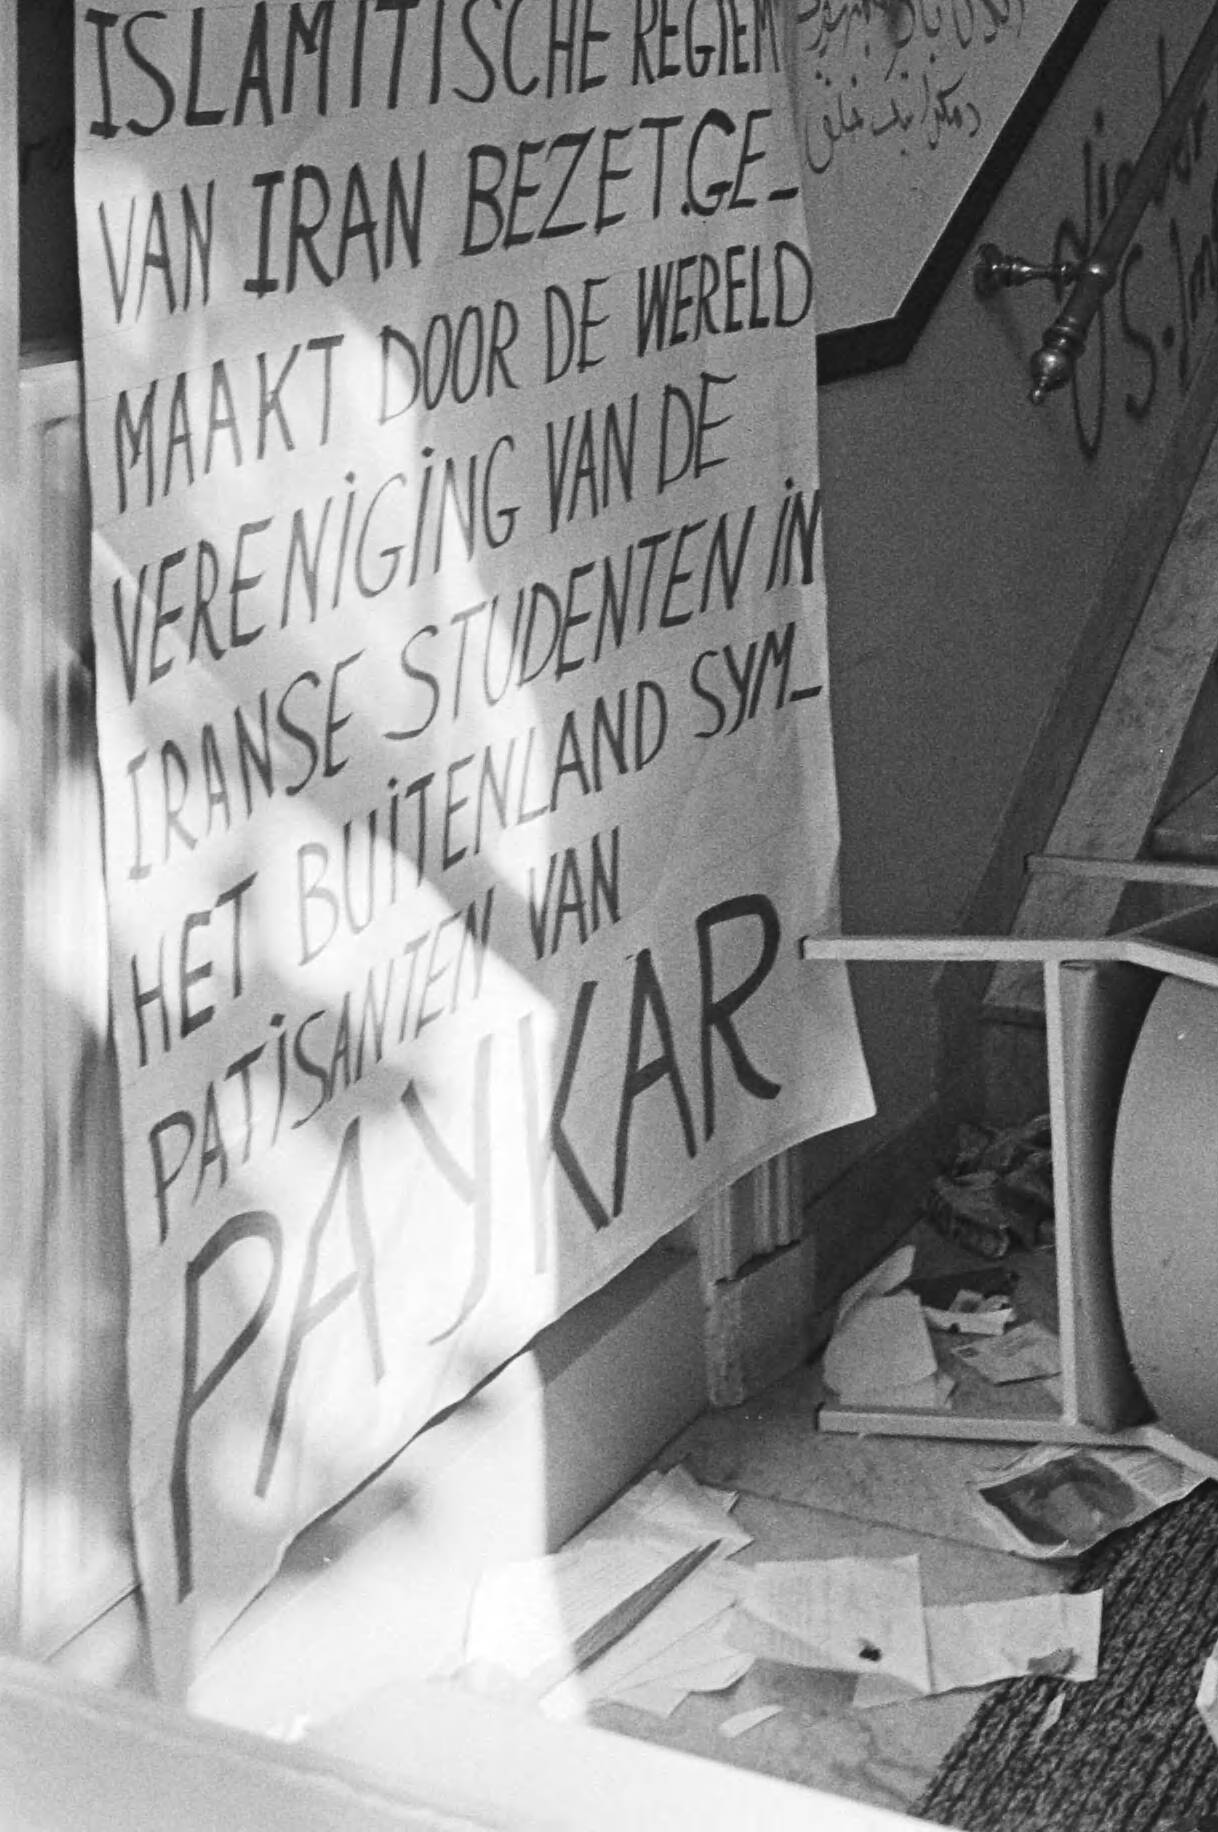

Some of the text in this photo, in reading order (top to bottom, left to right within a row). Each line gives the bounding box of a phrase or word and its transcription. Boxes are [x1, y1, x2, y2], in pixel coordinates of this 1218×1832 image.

[97, 178, 215, 326] VAN
[242, 148, 426, 298] IRAN
[112, 240, 815, 515] MAAKT DOOR DE WERELD
[547, 392, 640, 534] VAN
[657, 371, 739, 489] DE
[124, 648, 366, 883] IRANSE
[383, 503, 758, 743] STUDENTEN
[129, 874, 259, 1069] HET
[526, 826, 622, 962] VAN
[168, 892, 784, 1604] PAYKAR
